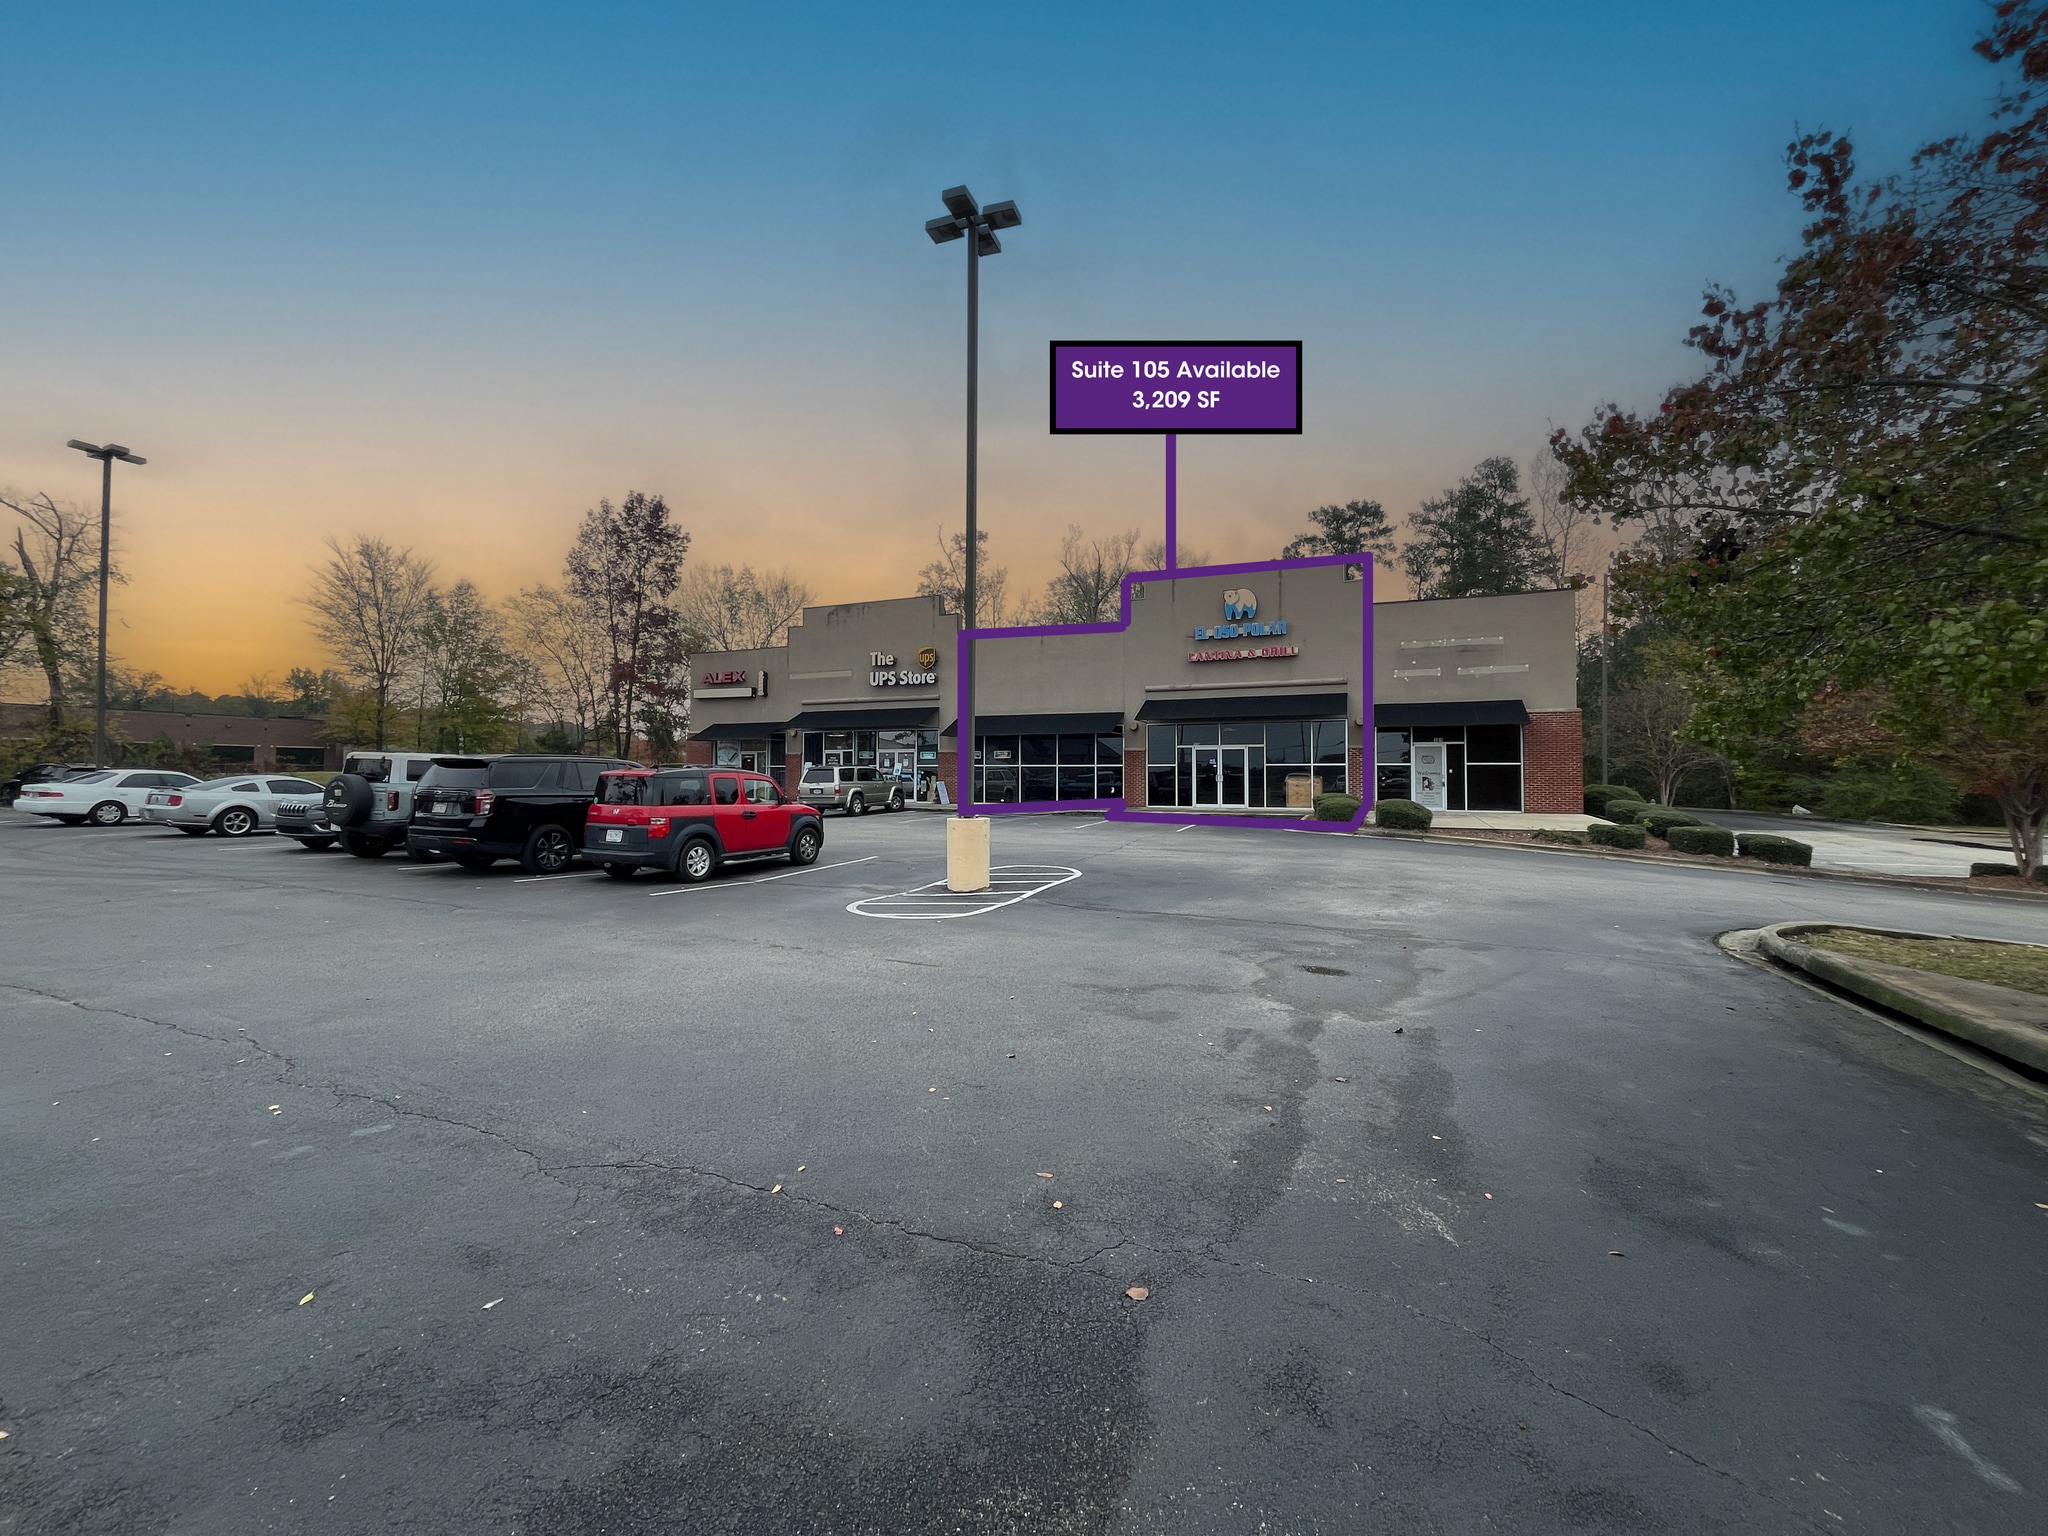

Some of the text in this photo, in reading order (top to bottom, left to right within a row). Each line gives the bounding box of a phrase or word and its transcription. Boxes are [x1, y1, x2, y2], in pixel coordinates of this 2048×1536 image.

[1195, 620, 1287, 640] EL OSO POLAR
[869, 651, 895, 666] The
[919, 653, 934, 666] ups
[1187, 646, 1299, 662] CANTINA & GRILL
[702, 670, 746, 684] ALEX
[869, 670, 936, 687] UPS Store
